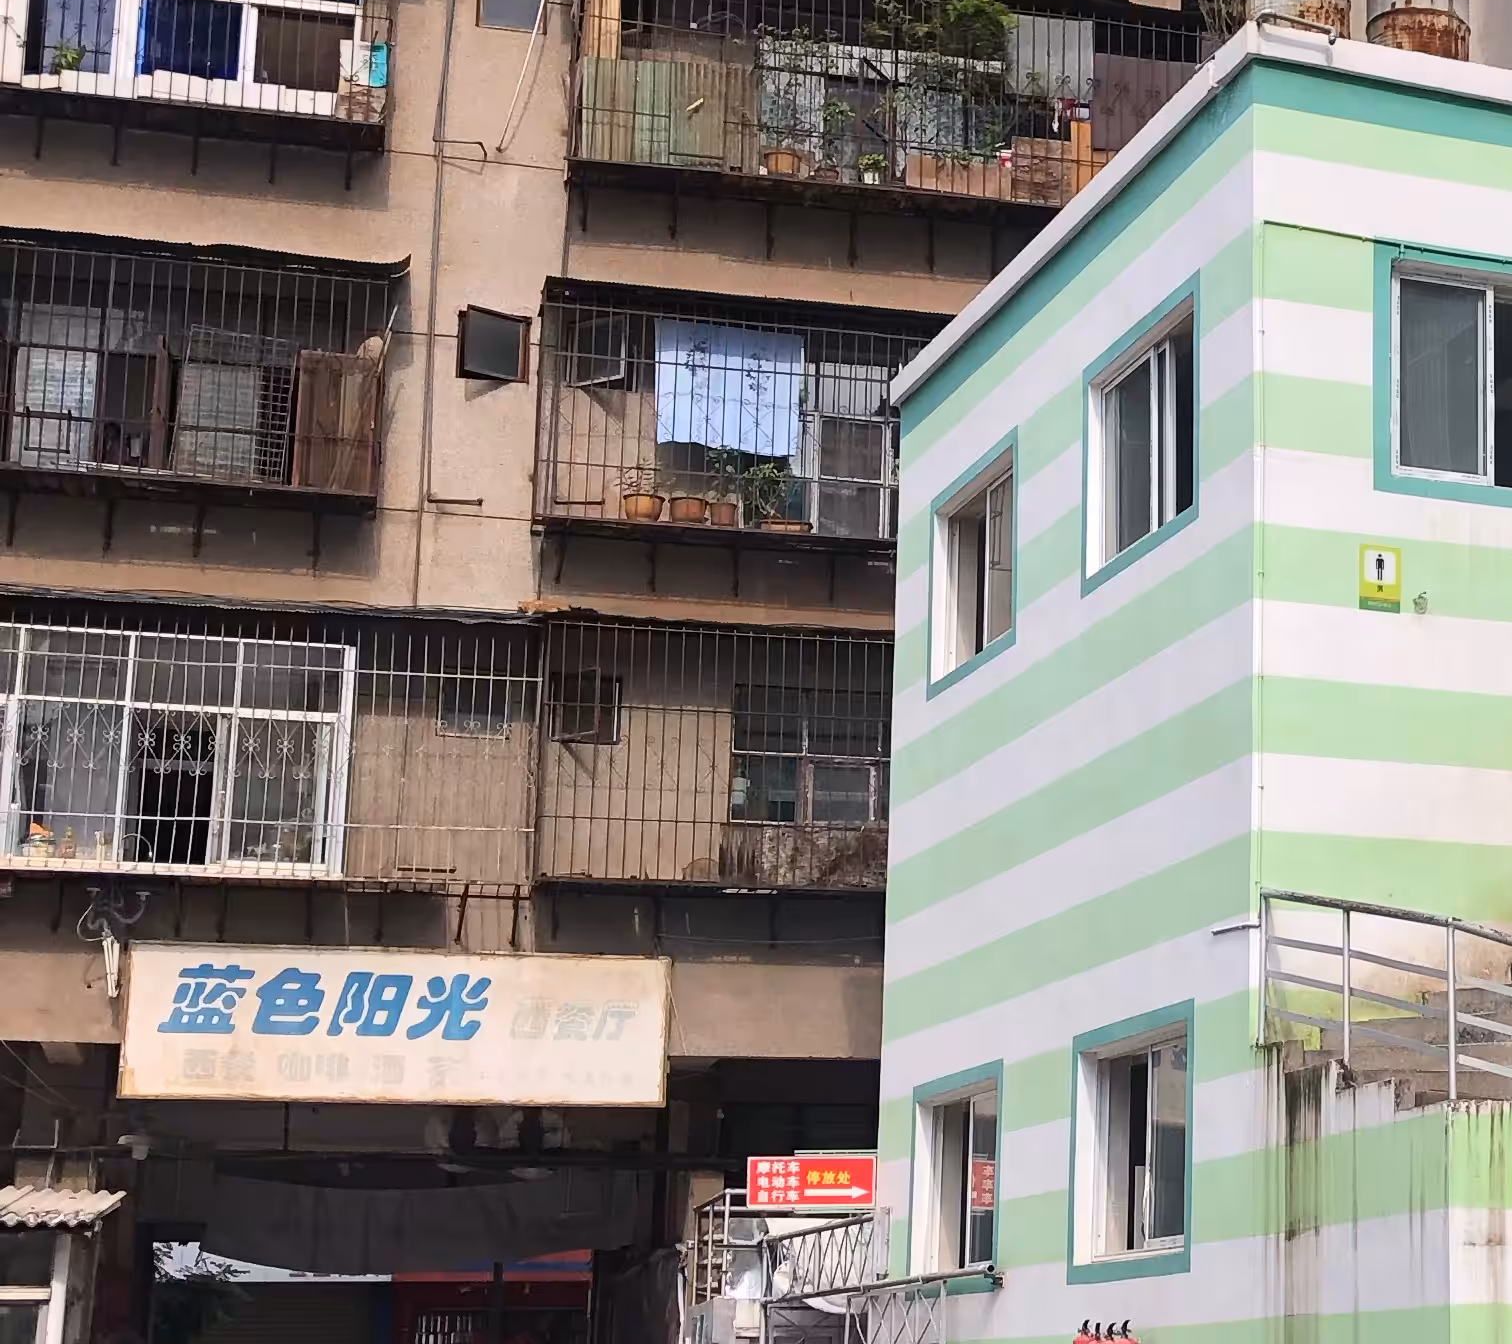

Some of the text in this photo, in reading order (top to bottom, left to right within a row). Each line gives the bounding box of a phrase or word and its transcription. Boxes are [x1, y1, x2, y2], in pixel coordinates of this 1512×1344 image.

[157, 963, 492, 1041] 蓝色阳光
[756, 1161, 800, 1174] 摩托车
[757, 1176, 800, 1188] 电动车
[806, 1171, 851, 1185] 停放处
[757, 1190, 800, 1202] 自行车
